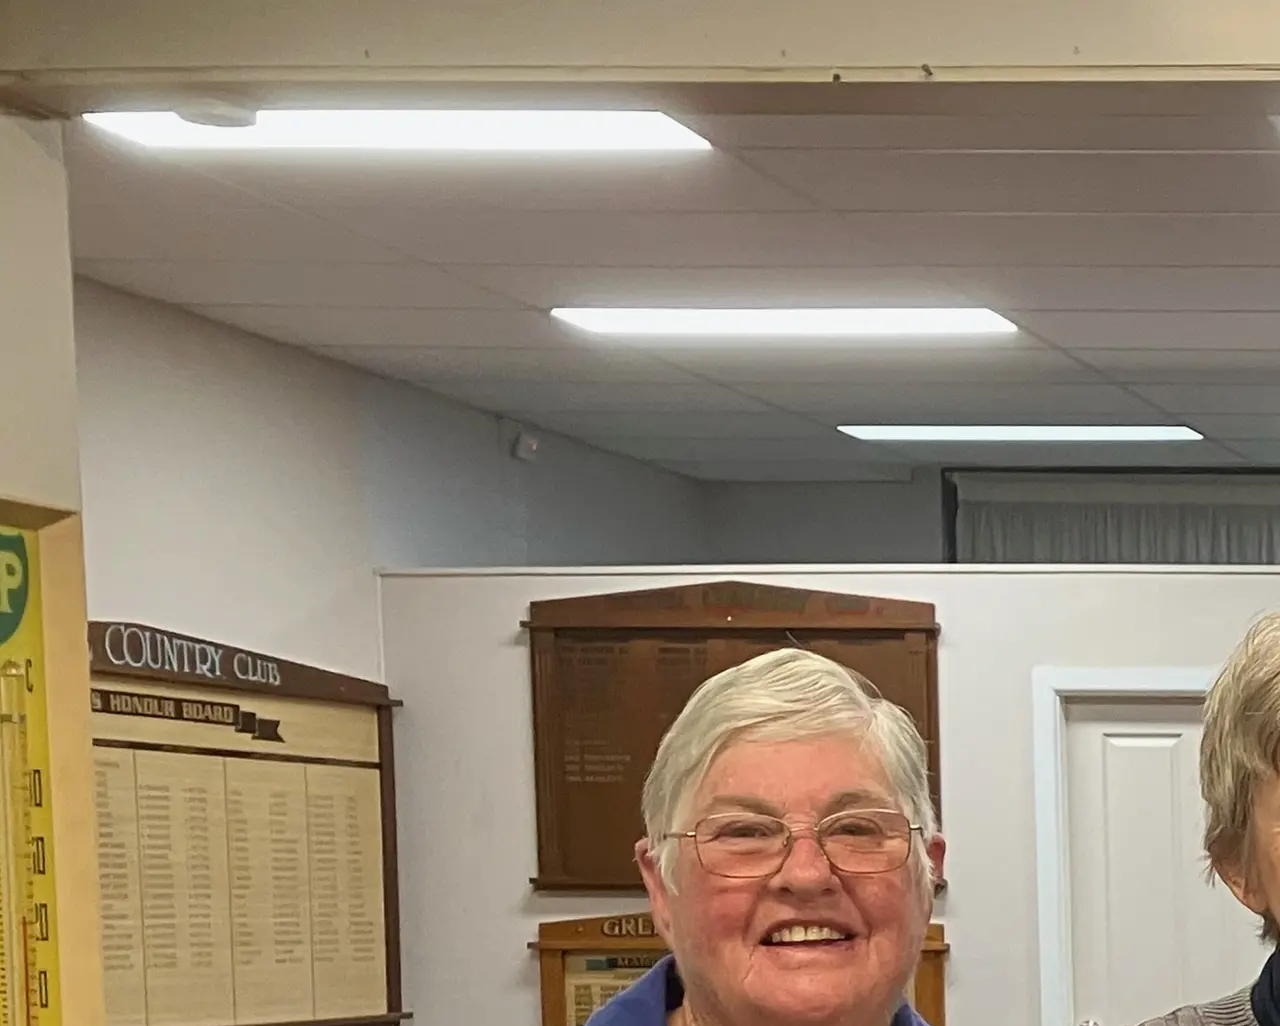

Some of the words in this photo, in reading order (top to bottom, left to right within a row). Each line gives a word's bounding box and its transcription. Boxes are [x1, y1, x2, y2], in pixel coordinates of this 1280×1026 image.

[104, 624, 223, 679] COUNTRY
[234, 653, 281, 686] CLUB
[109, 693, 176, 718] HONOUR
[182, 702, 235, 725] BOARD
[602, 917, 661, 937] GRE
